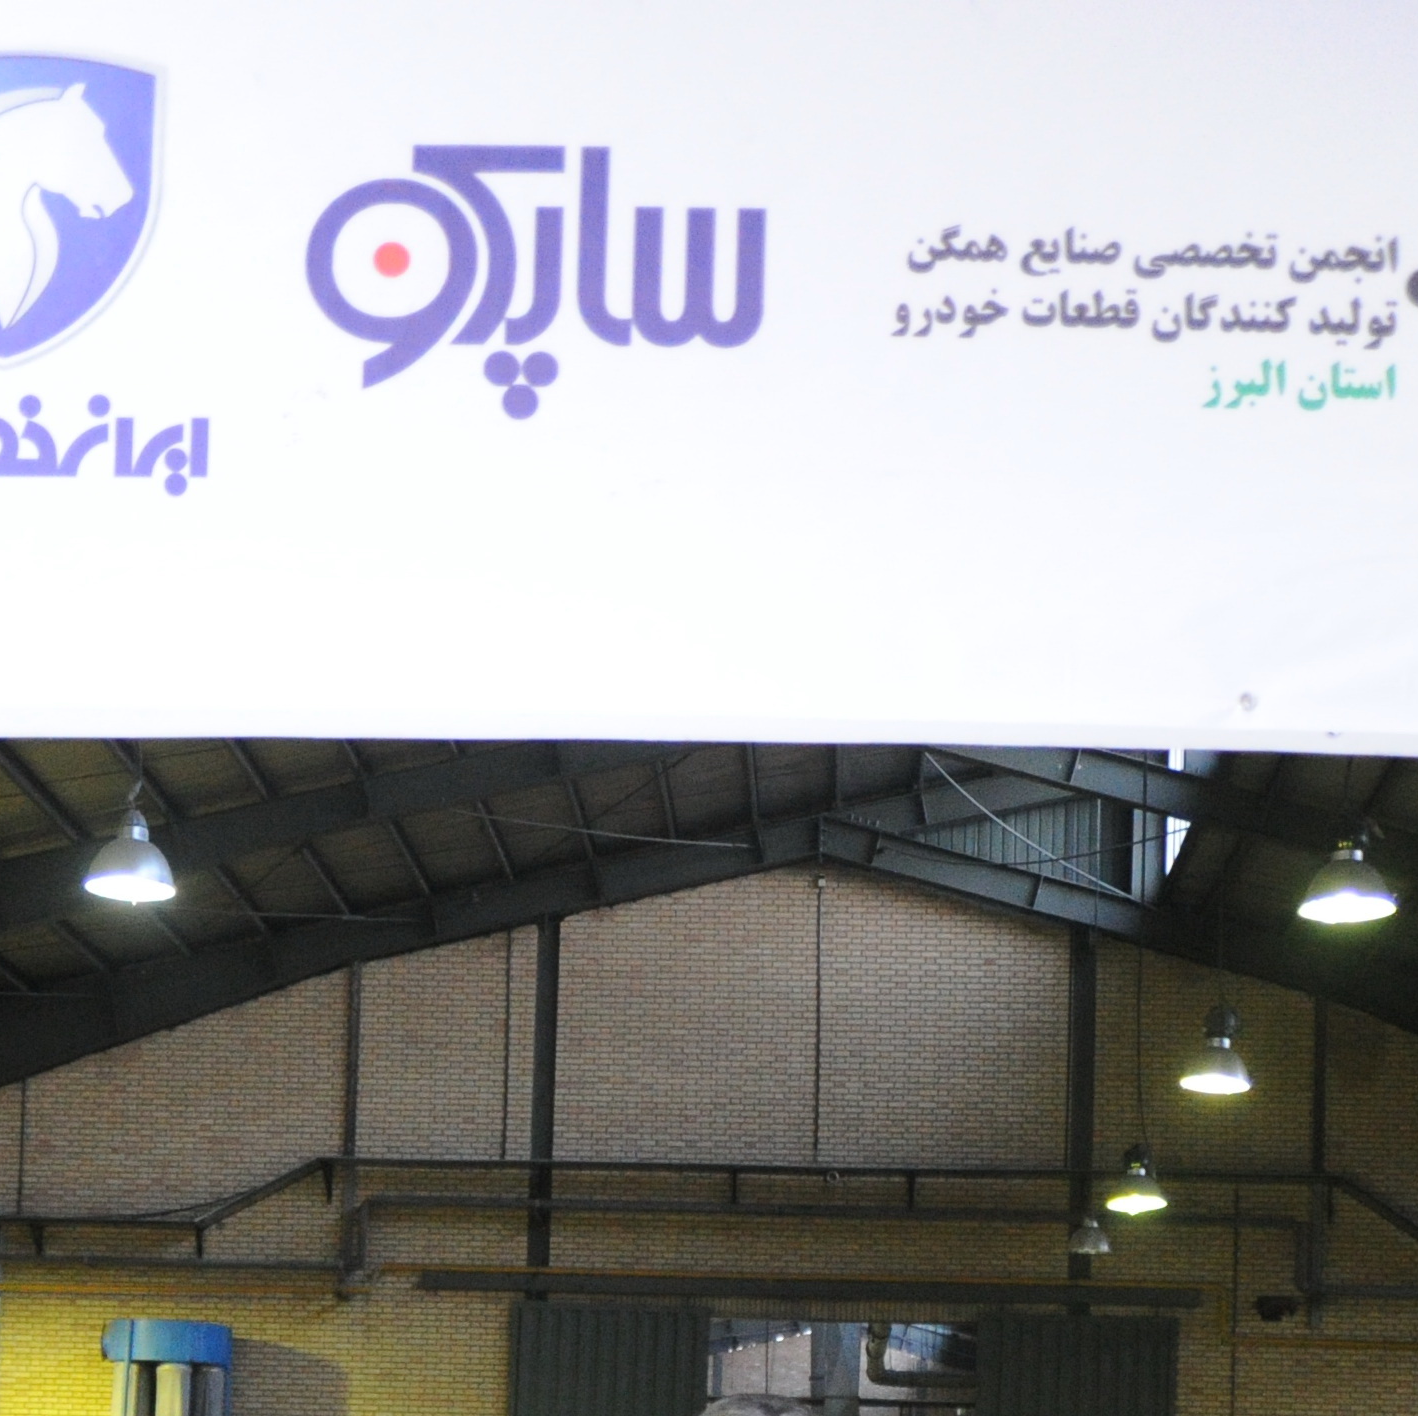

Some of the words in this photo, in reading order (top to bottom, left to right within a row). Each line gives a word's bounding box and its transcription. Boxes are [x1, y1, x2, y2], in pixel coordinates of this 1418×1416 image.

[906, 225, 1009, 275] همگن
[1019, 226, 1122, 278] صنایع
[1133, 230, 1279, 281] تخصصی
[1288, 236, 1399, 284] انجمن
[891, 289, 1010, 338] خودرو
[1021, 289, 1141, 330] قطعات
[1151, 290, 1297, 343] کنندگان
[1308, 295, 1398, 350] تولید
[1202, 358, 1288, 411] البرز
[1297, 361, 1397, 412] استان
